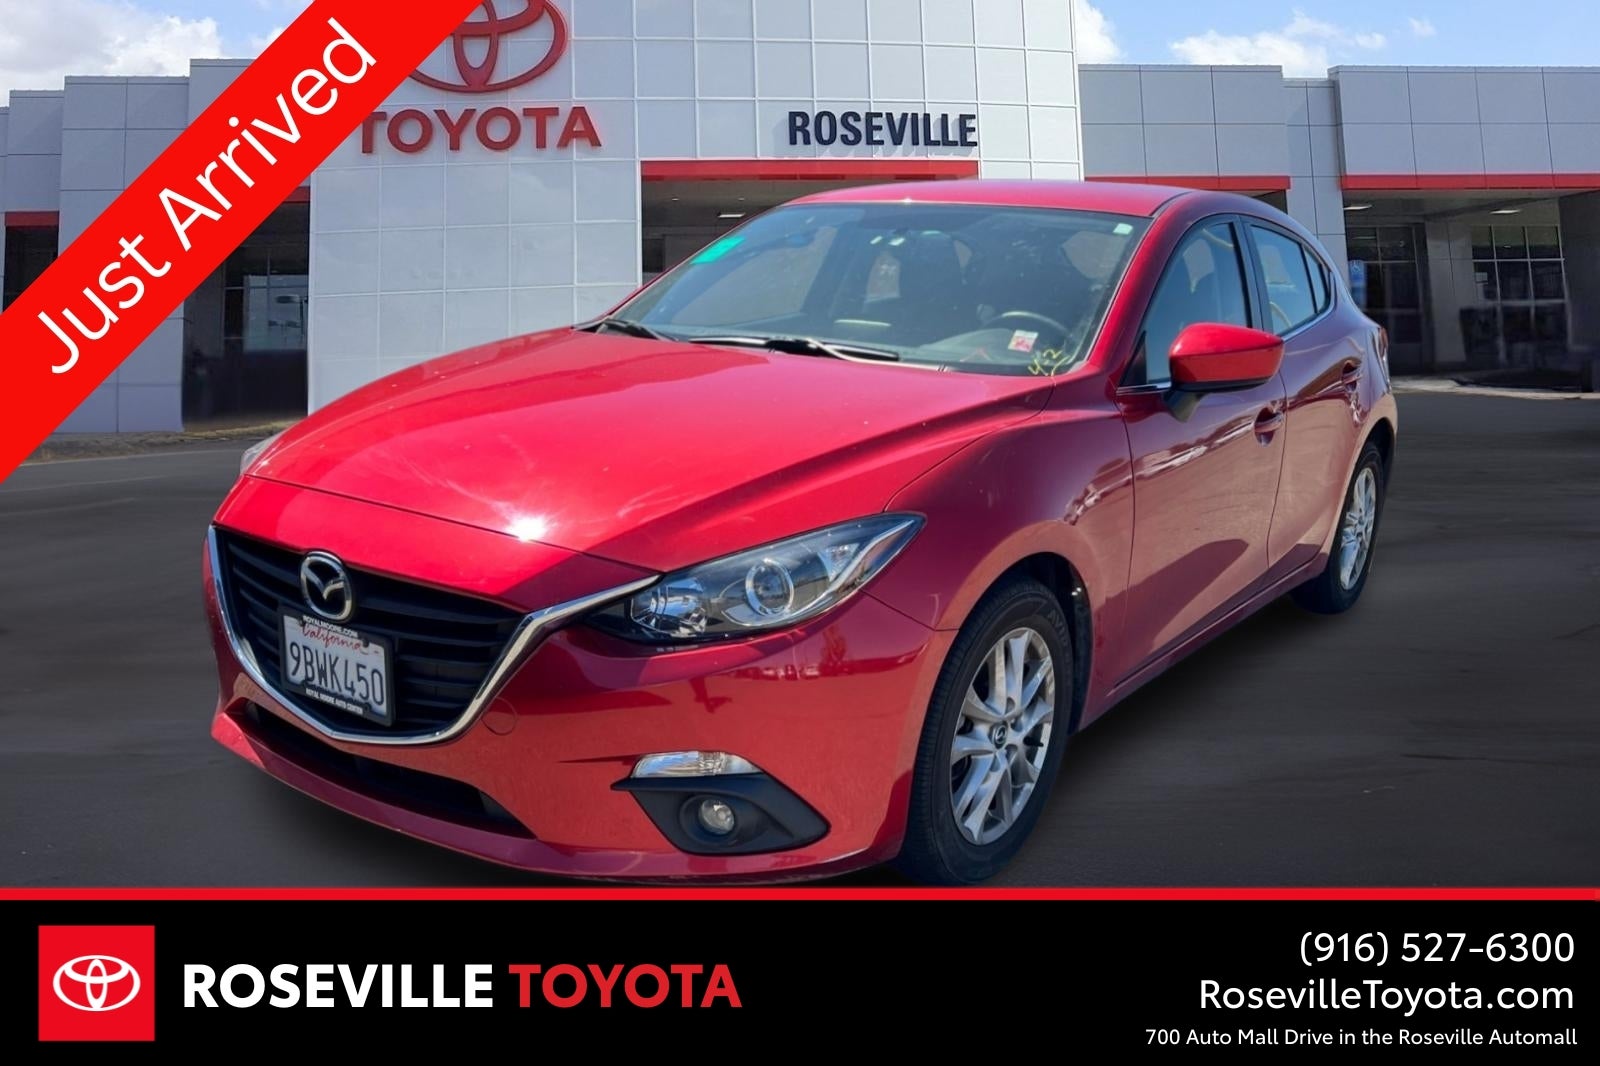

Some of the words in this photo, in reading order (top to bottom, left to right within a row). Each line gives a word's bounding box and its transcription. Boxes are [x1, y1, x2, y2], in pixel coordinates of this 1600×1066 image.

[362, 106, 603, 154] TOYOTA
[788, 110, 978, 147] ROSEVILLE
[302, 622, 362, 650] California
[289, 641, 384, 706] 9BWK450
